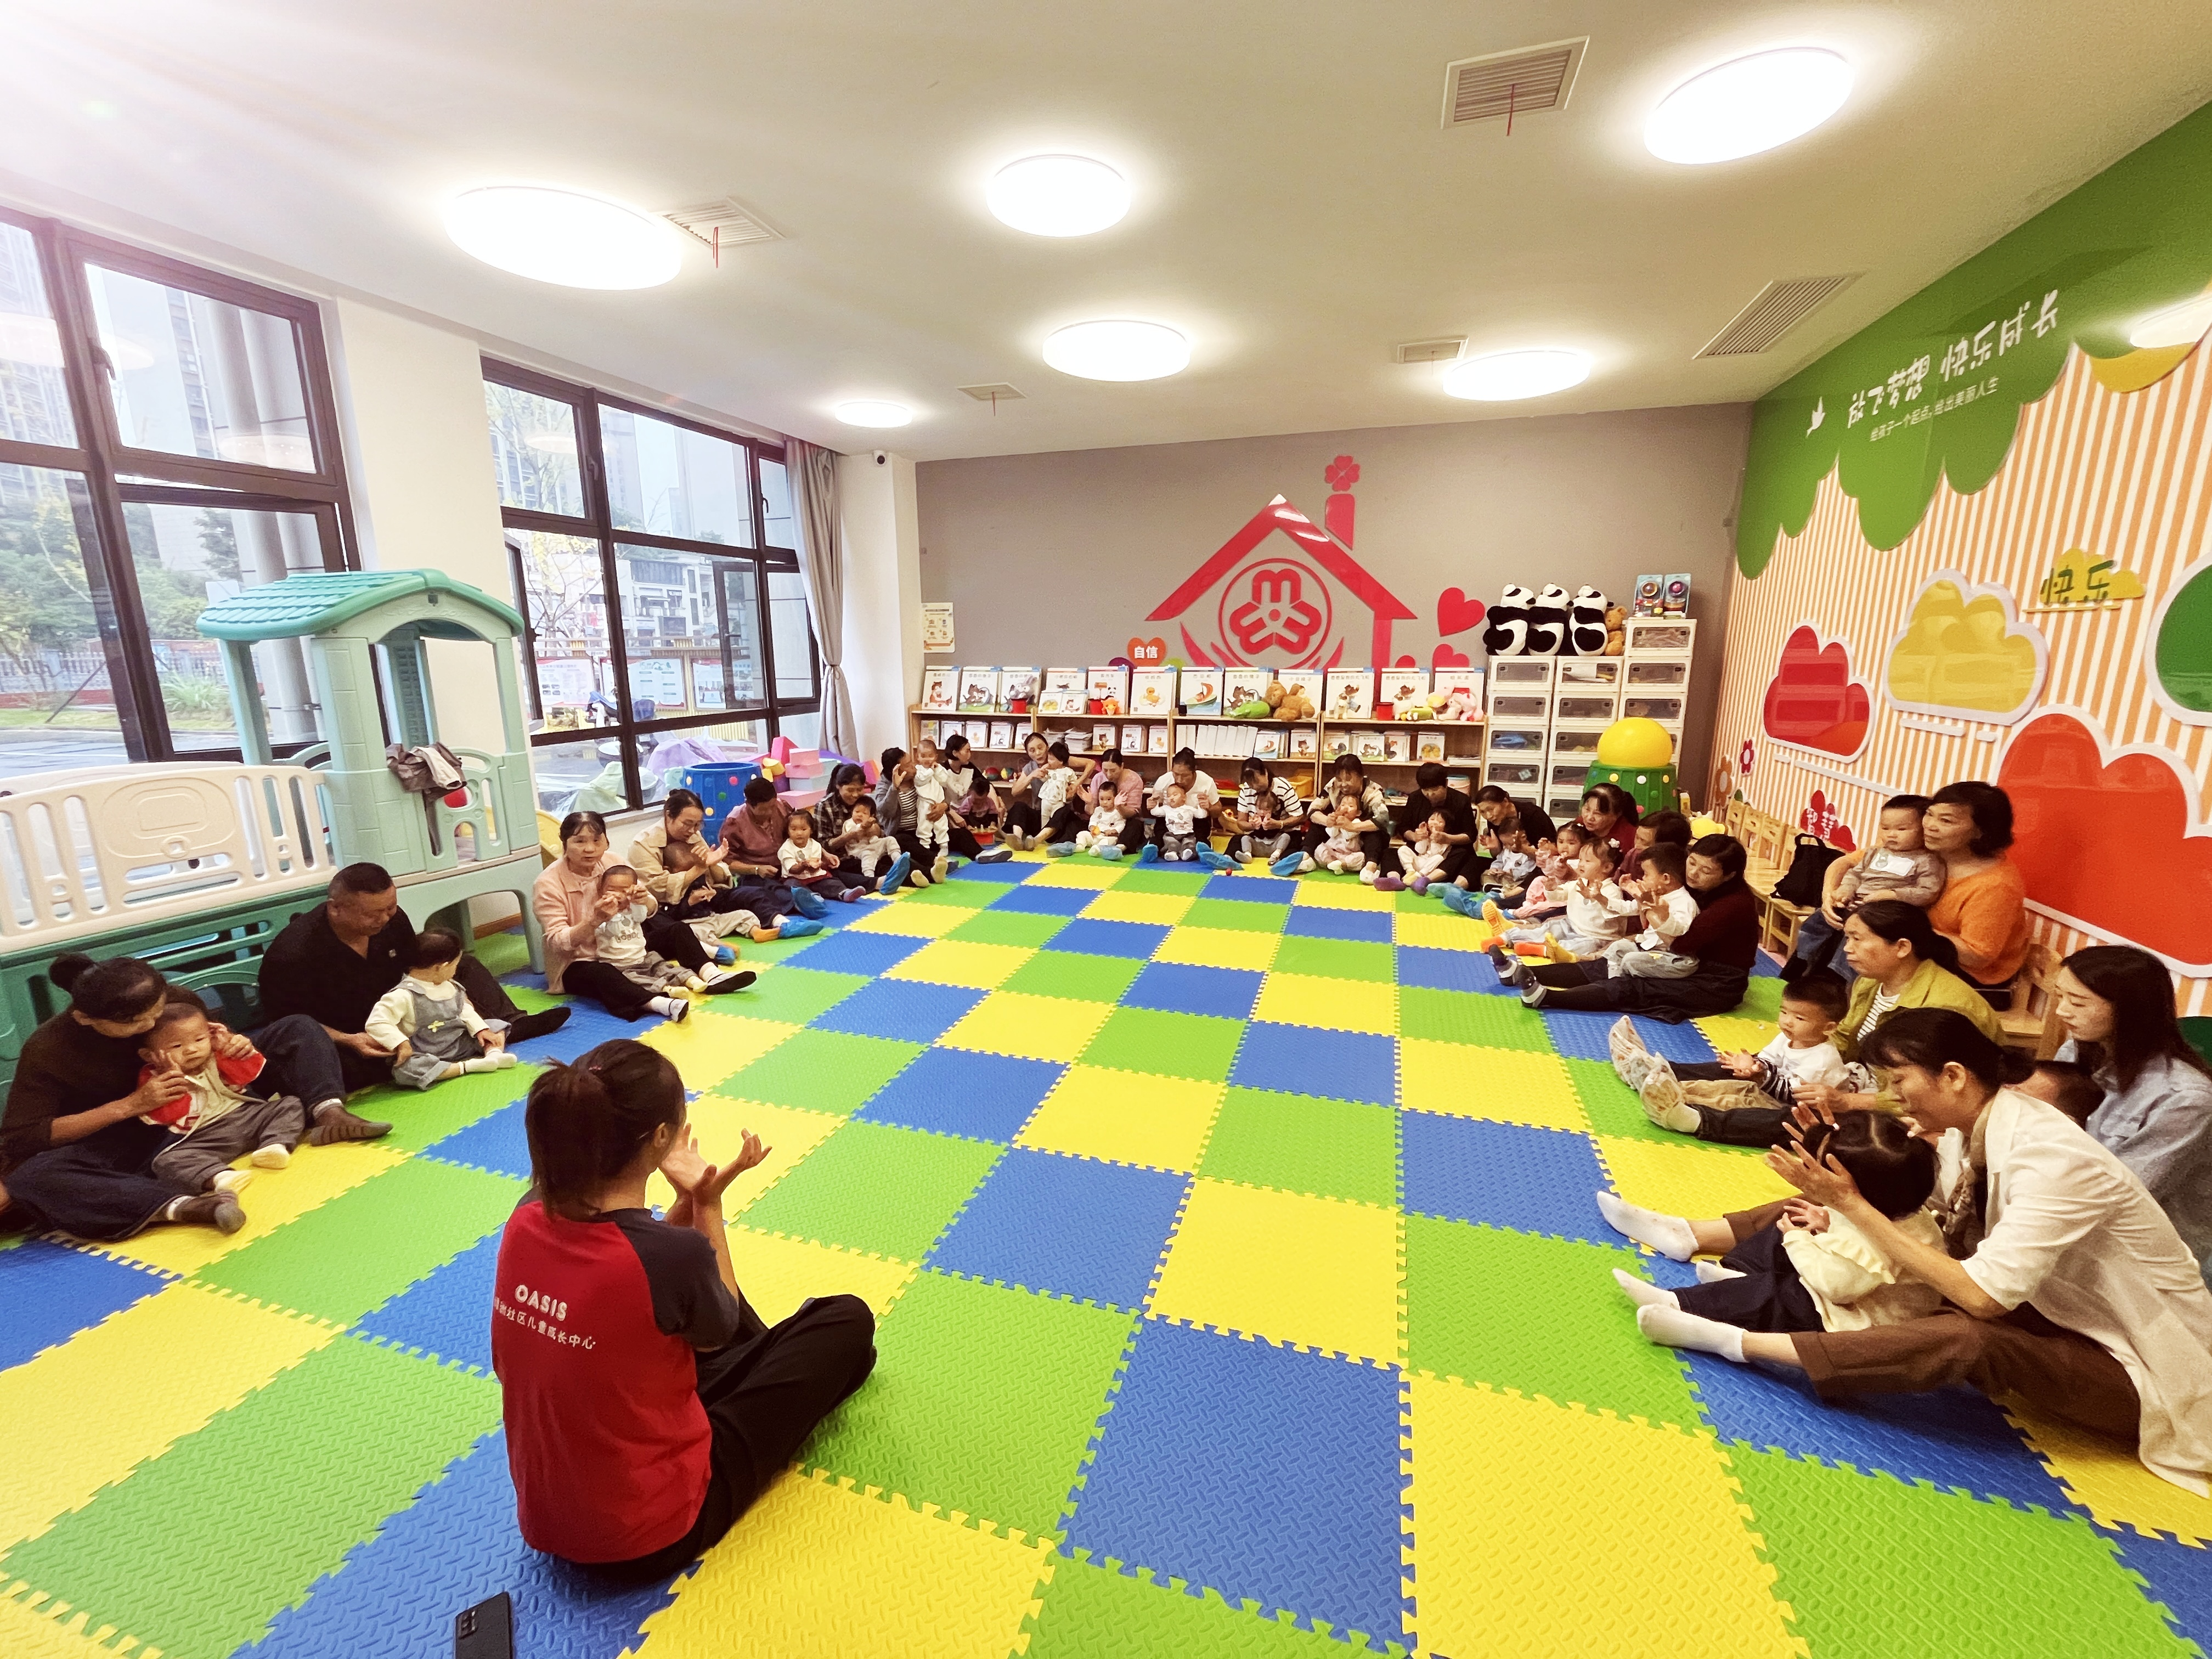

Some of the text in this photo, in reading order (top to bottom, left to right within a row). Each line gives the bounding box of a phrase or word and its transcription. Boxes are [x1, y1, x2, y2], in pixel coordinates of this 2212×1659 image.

[1847, 289, 2058, 429] 放飞梦想 快乐成长
[2040, 560, 2116, 606] 快乐
[1134, 646, 1158, 659] 自信
[515, 1284, 568, 1322] OASIS
